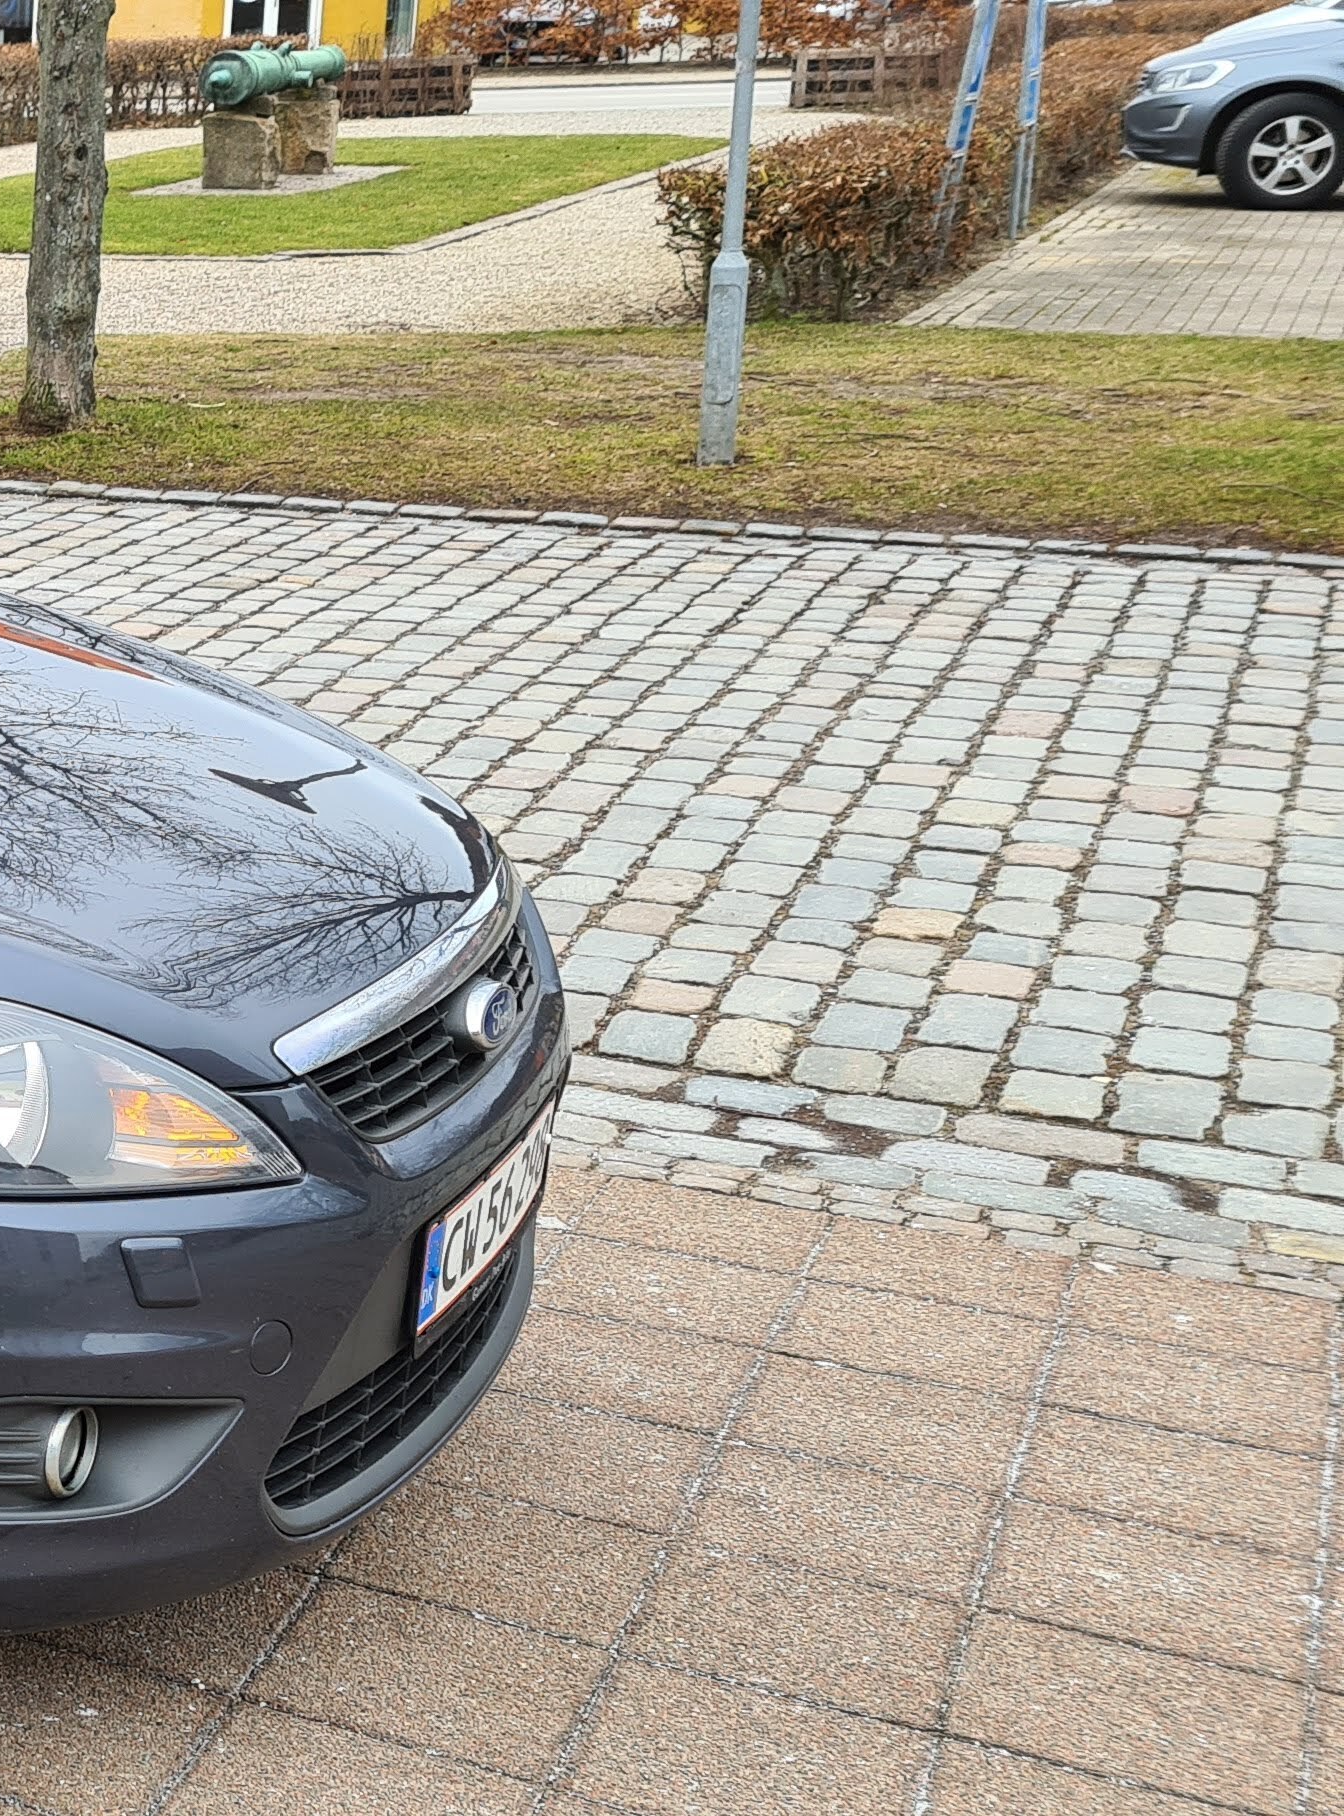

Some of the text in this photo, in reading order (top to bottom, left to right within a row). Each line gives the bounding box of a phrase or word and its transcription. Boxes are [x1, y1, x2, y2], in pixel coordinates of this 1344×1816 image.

[441, 1197, 484, 1292] CW
[482, 1161, 515, 1254] 56
[420, 1283, 433, 1309] DK
